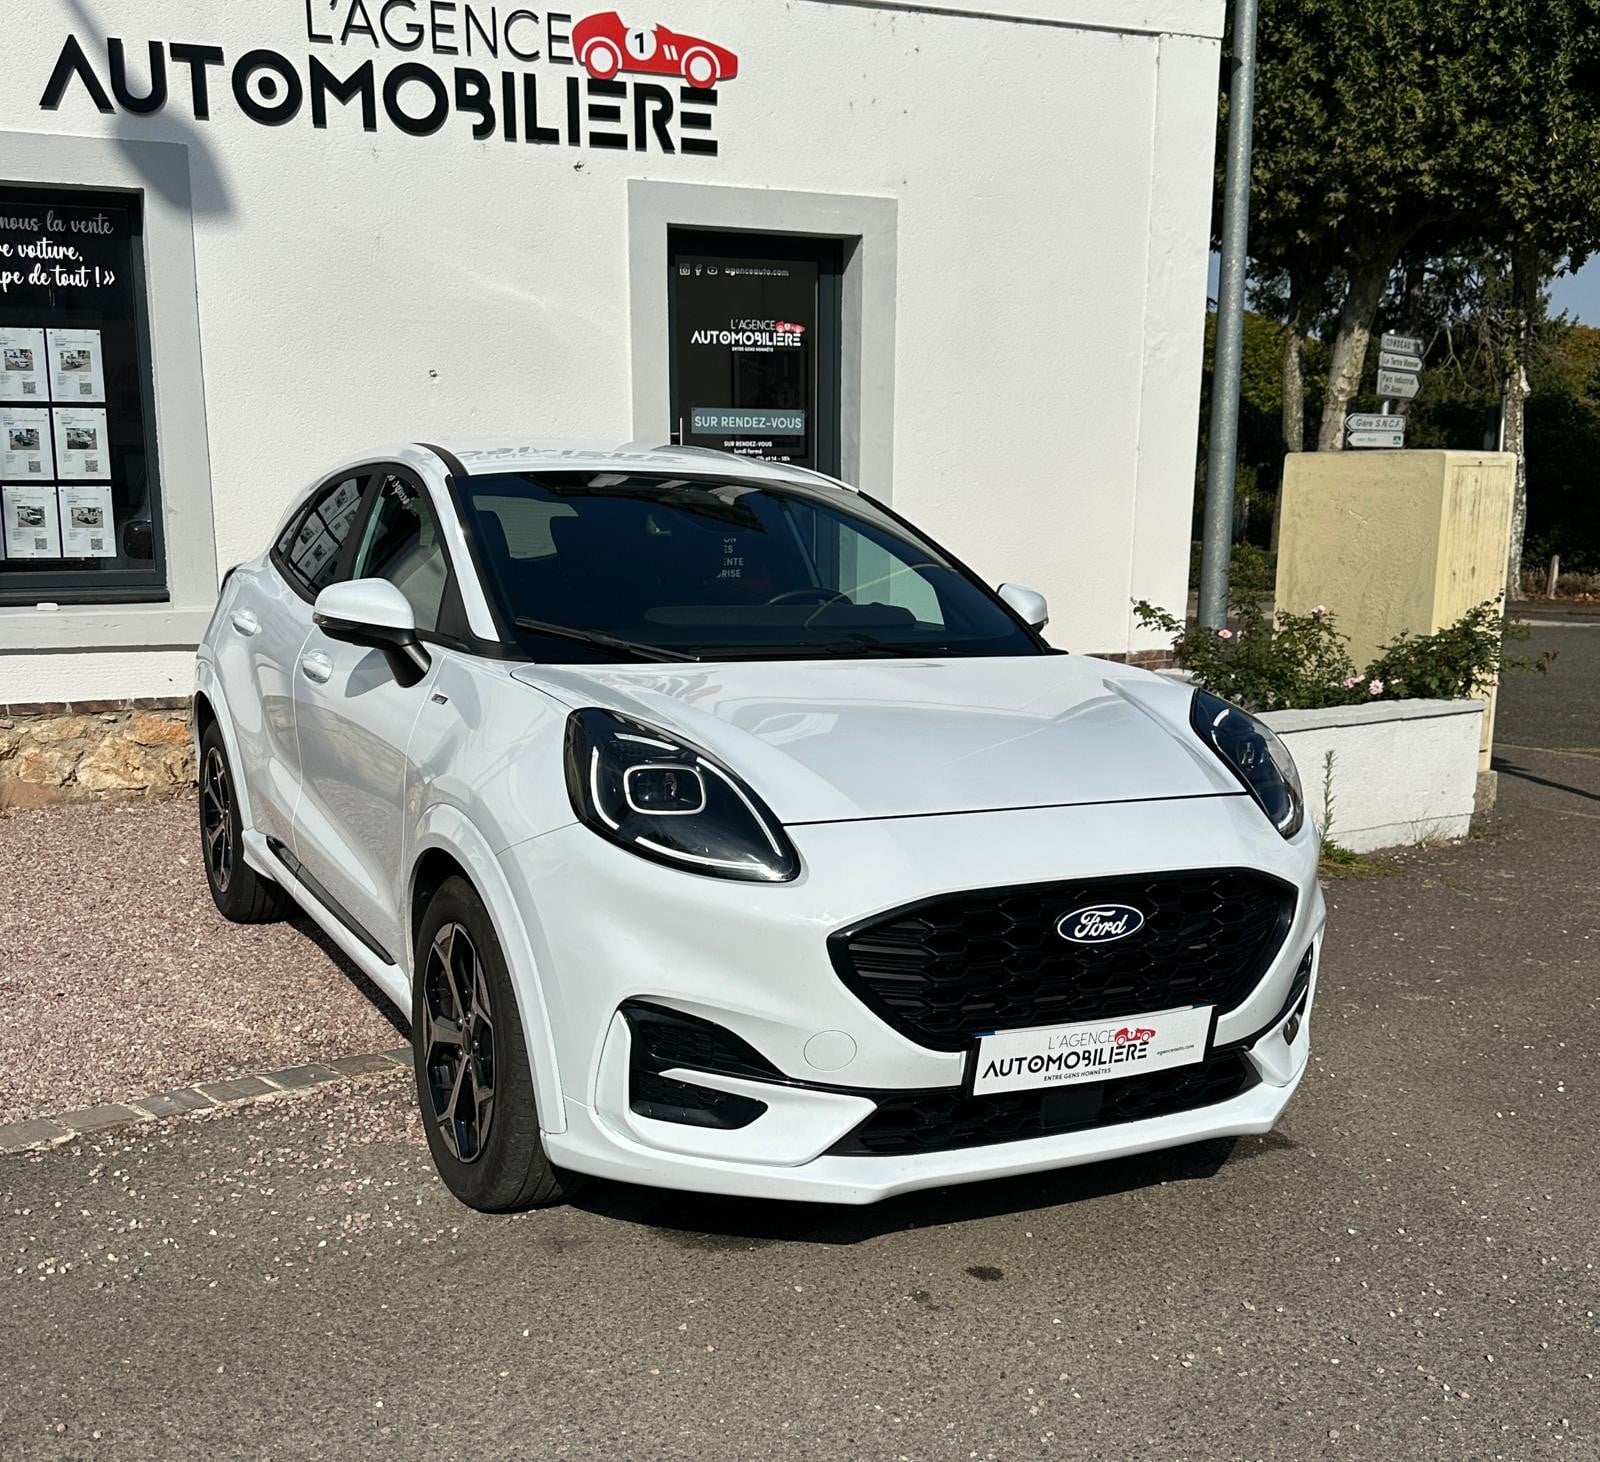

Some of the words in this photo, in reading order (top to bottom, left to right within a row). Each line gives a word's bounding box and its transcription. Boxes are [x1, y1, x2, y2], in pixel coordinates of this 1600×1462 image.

[46, 209, 67, 233] la
[70, 213, 114, 235] vente
[17, 236, 84, 262] voiture,
[28, 263, 52, 285] de
[50, 264, 92, 288] tout
[730, 319, 777, 332] L'AGENCE
[694, 415, 717, 428] SUR
[720, 416, 803, 429] RENDEZ-VOUS
[735, 440, 773, 448] RENDEZ-VOUS
[1074, 909, 1129, 938] Ford
[1048, 1028, 1116, 1050] L'AGENCE
[1043, 1072, 1063, 1082] ENTRE
[1063, 1070, 1080, 1080] GENS
